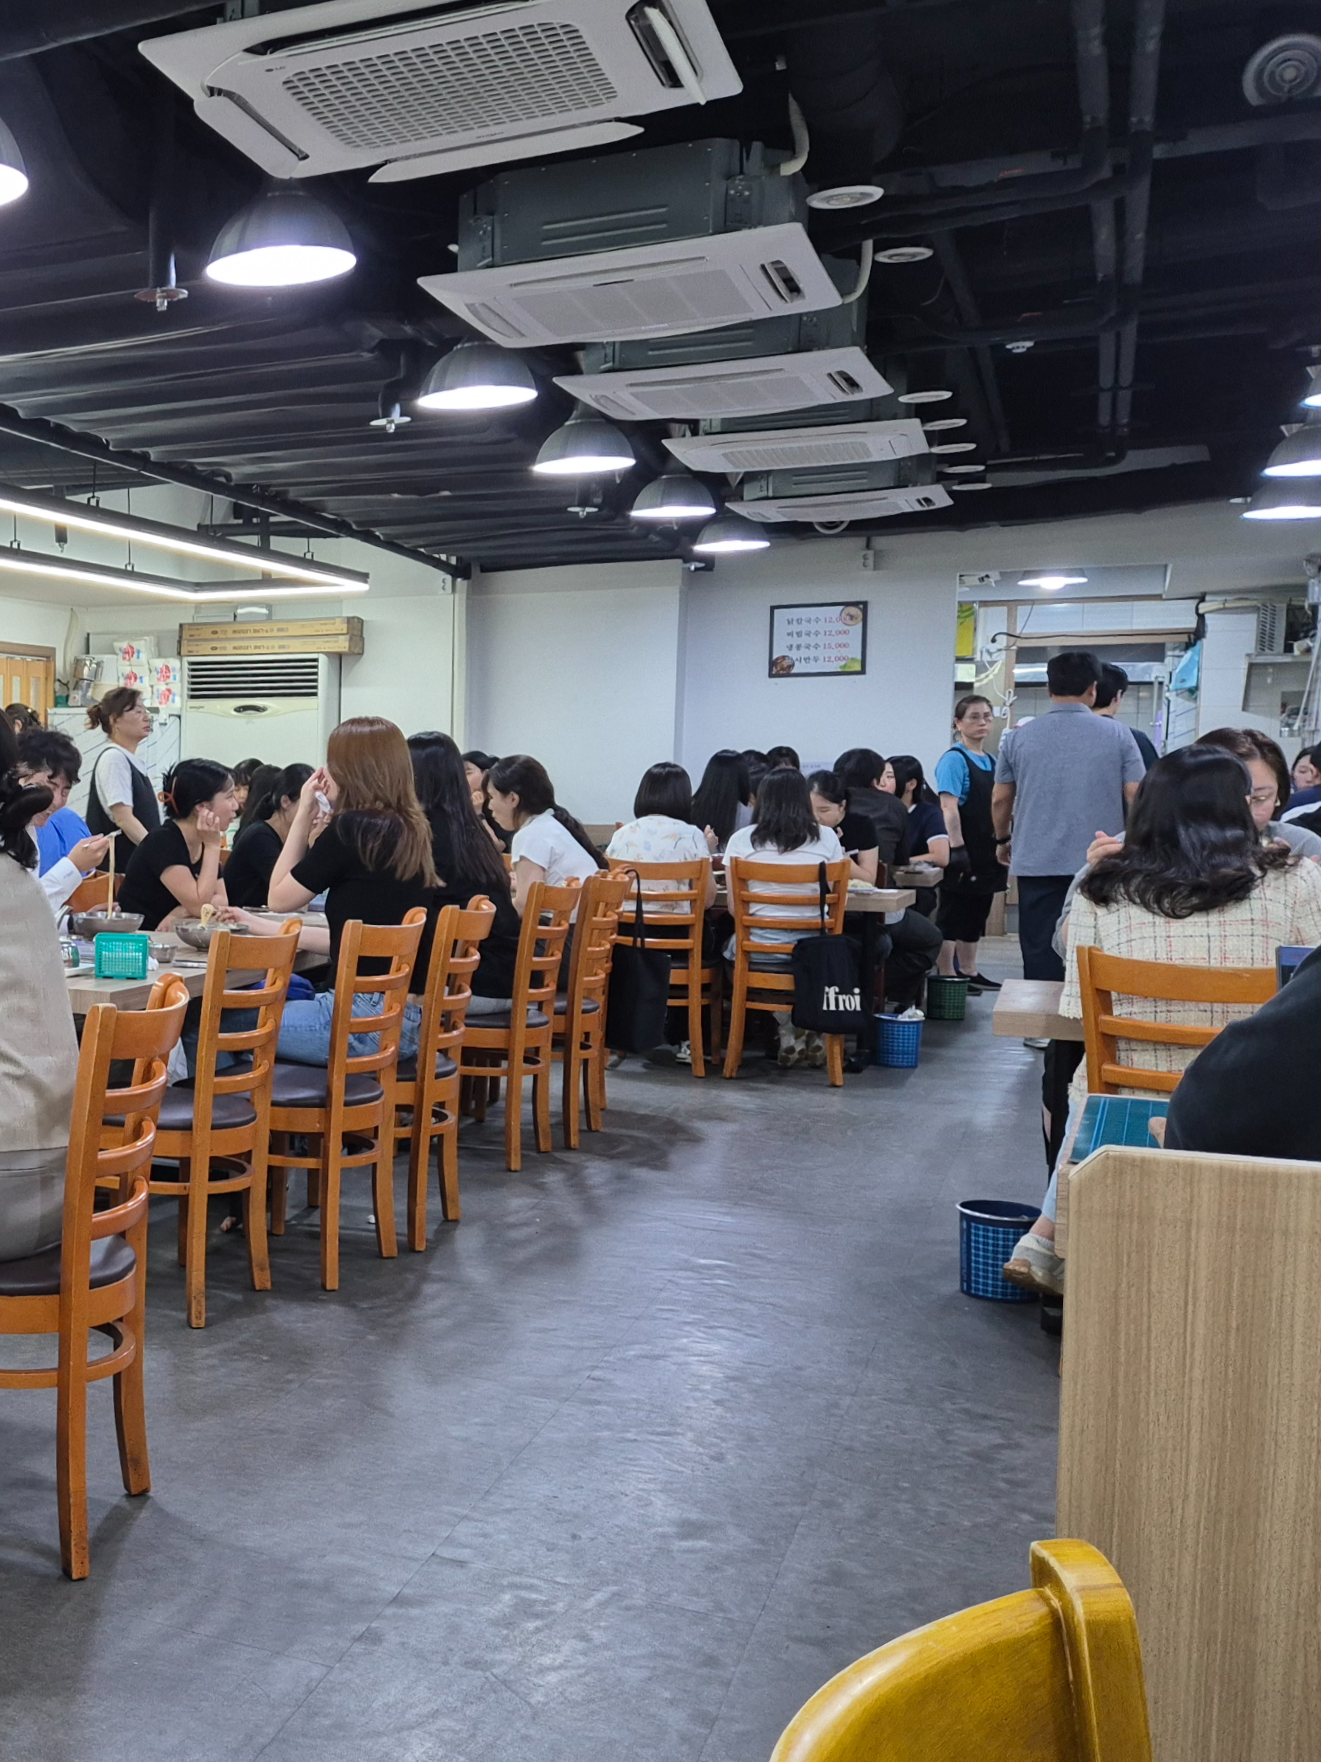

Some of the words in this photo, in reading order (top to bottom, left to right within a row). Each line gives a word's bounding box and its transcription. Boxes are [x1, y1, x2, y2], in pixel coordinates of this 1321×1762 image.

[823, 629, 850, 637] 12,000
[823, 642, 850, 650] 15,000
[822, 655, 849, 664] 12,000
